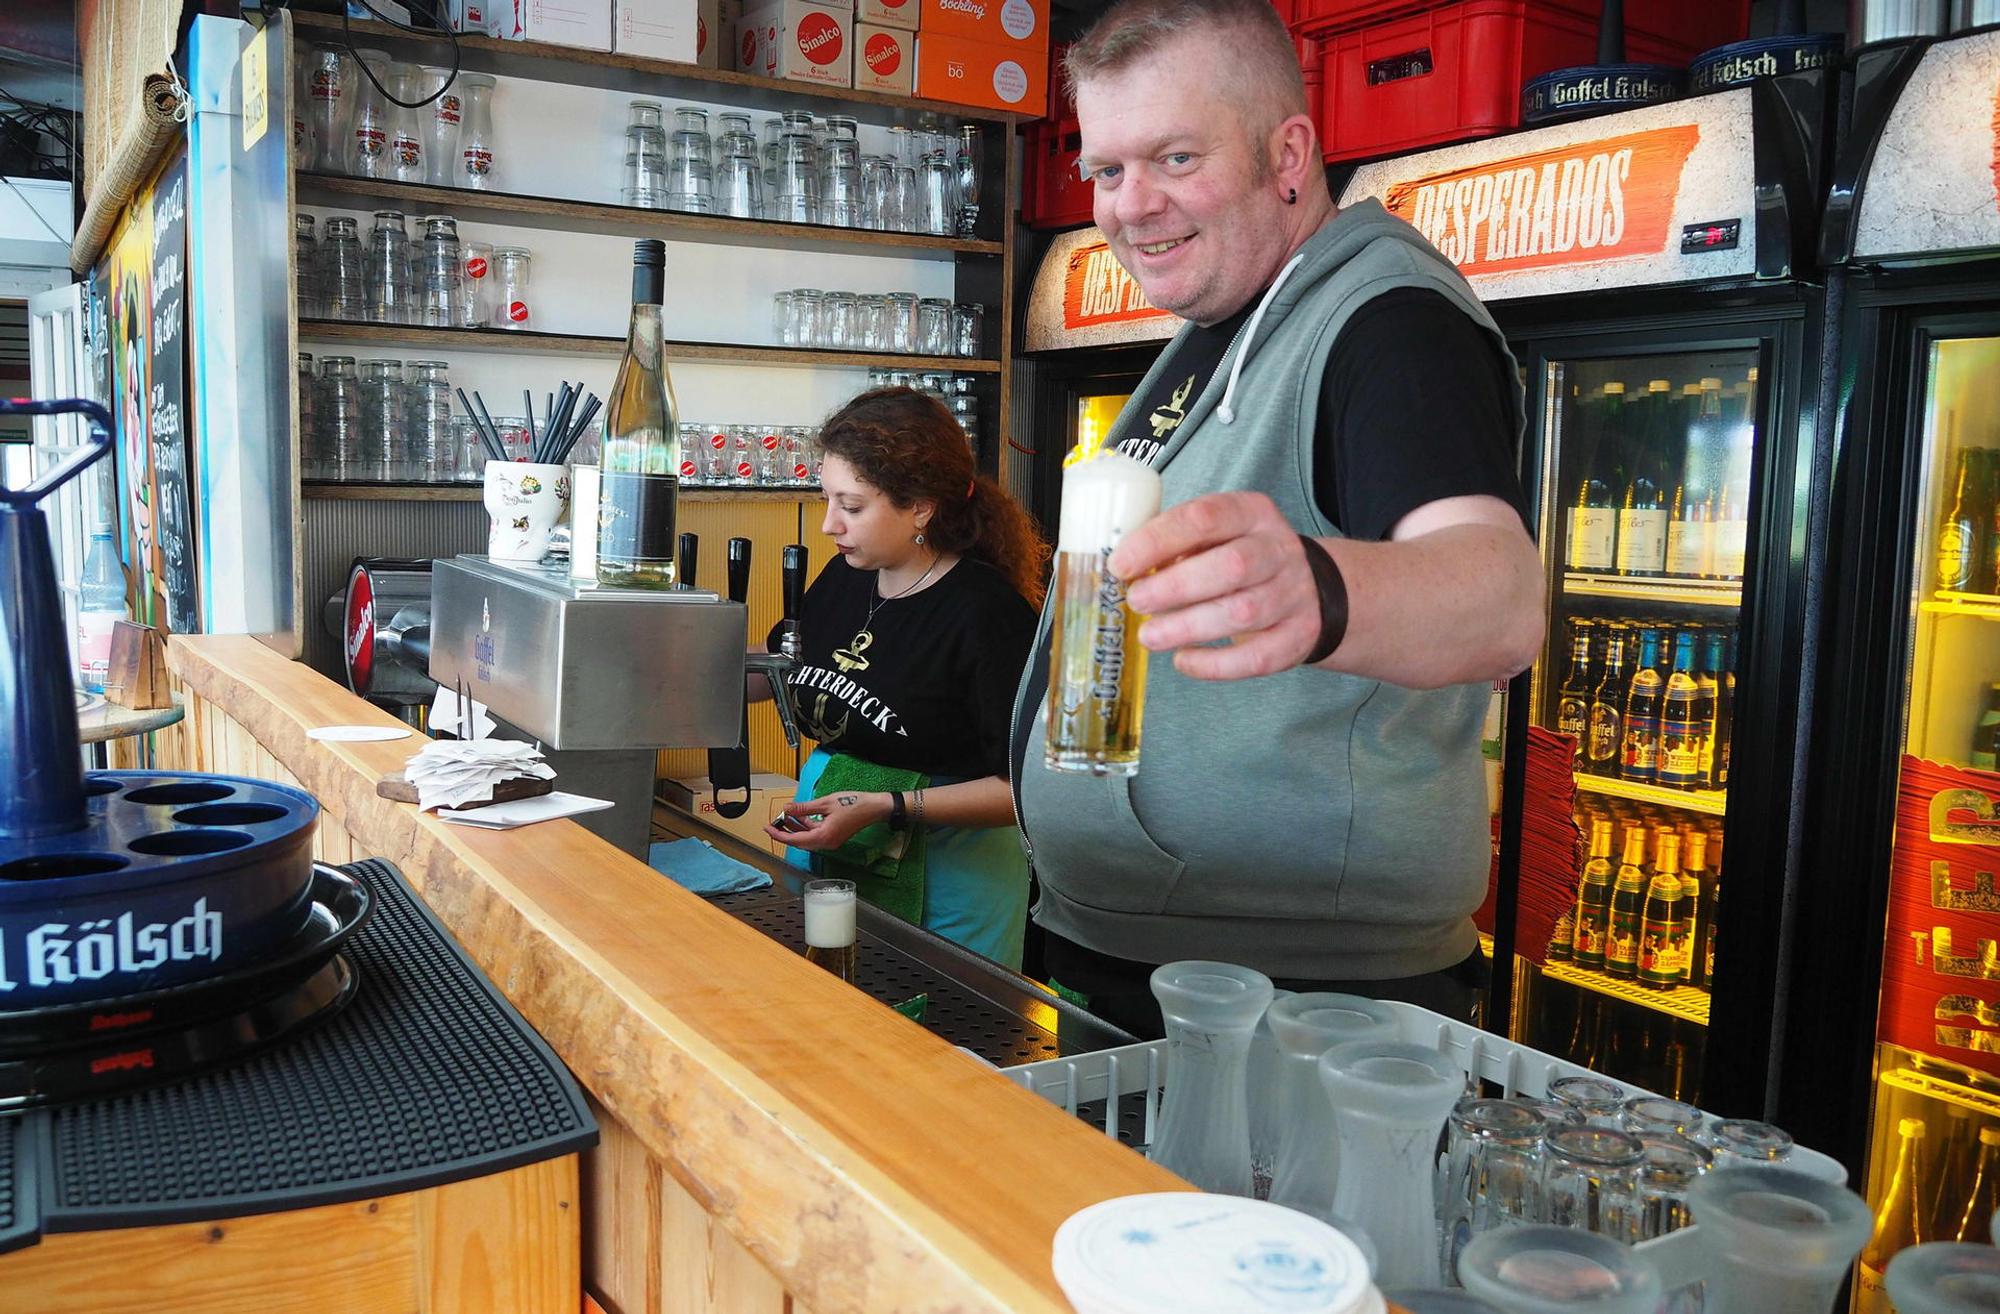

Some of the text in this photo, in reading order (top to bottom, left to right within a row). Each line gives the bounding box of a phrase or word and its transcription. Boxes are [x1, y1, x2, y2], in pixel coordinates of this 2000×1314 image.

[800, 26, 840, 54] Sinalco
[866, 44, 899, 67] Sinalco
[948, 64, 964, 79] bö
[1412, 148, 1634, 267] DESPERADOS
[349, 600, 373, 666] Sinalco
[787, 665, 898, 733] CHTERDECK
[26, 896, 223, 987] Kölsch
